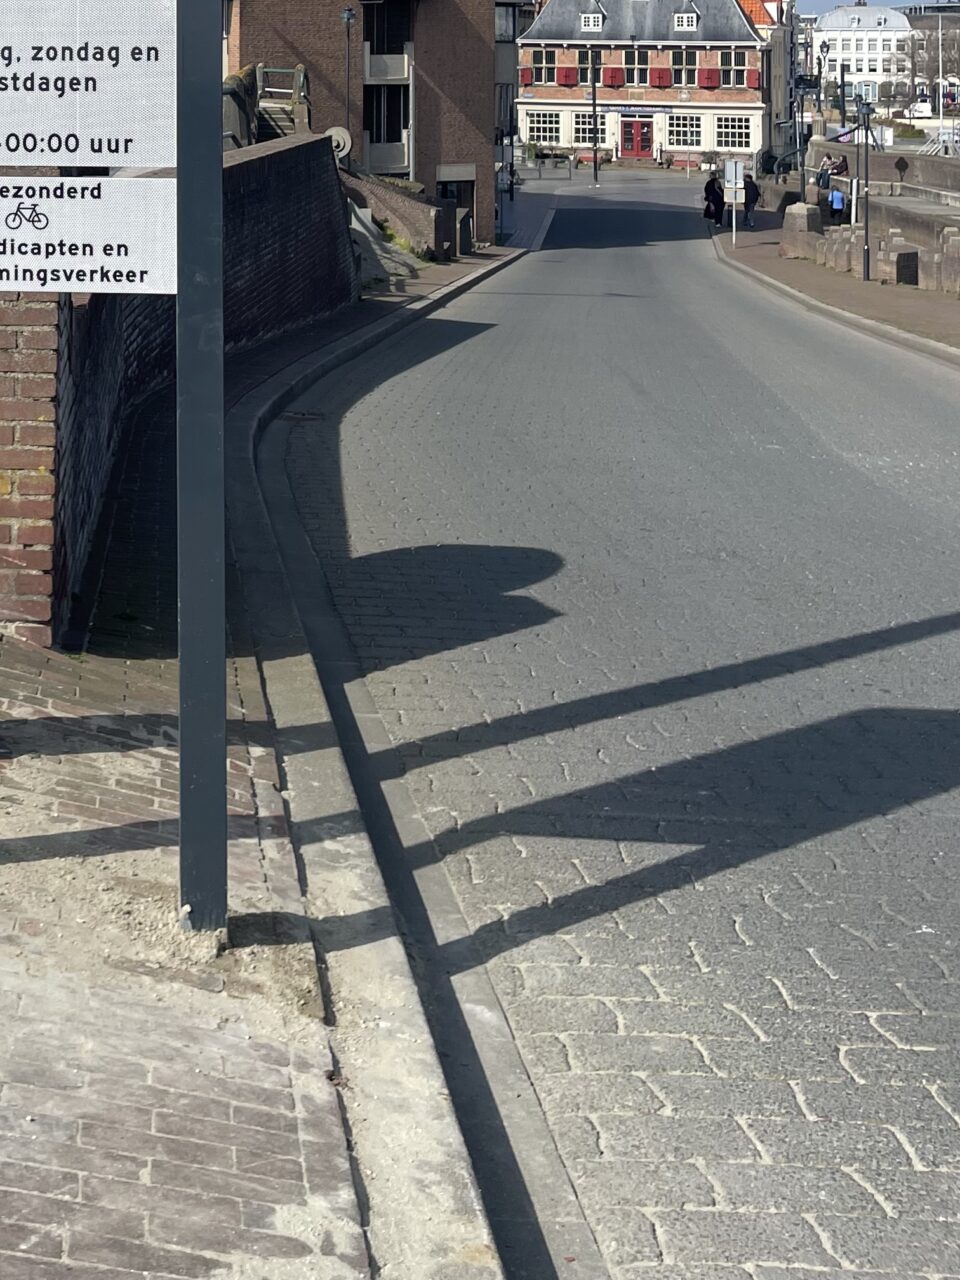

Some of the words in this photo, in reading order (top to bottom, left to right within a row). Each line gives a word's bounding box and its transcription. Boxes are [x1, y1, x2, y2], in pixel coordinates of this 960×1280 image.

[31, 41, 120, 68] zondag
[130, 46, 159, 62] en
[90, 137, 134, 154] uur
[102, 243, 129, 257] en
